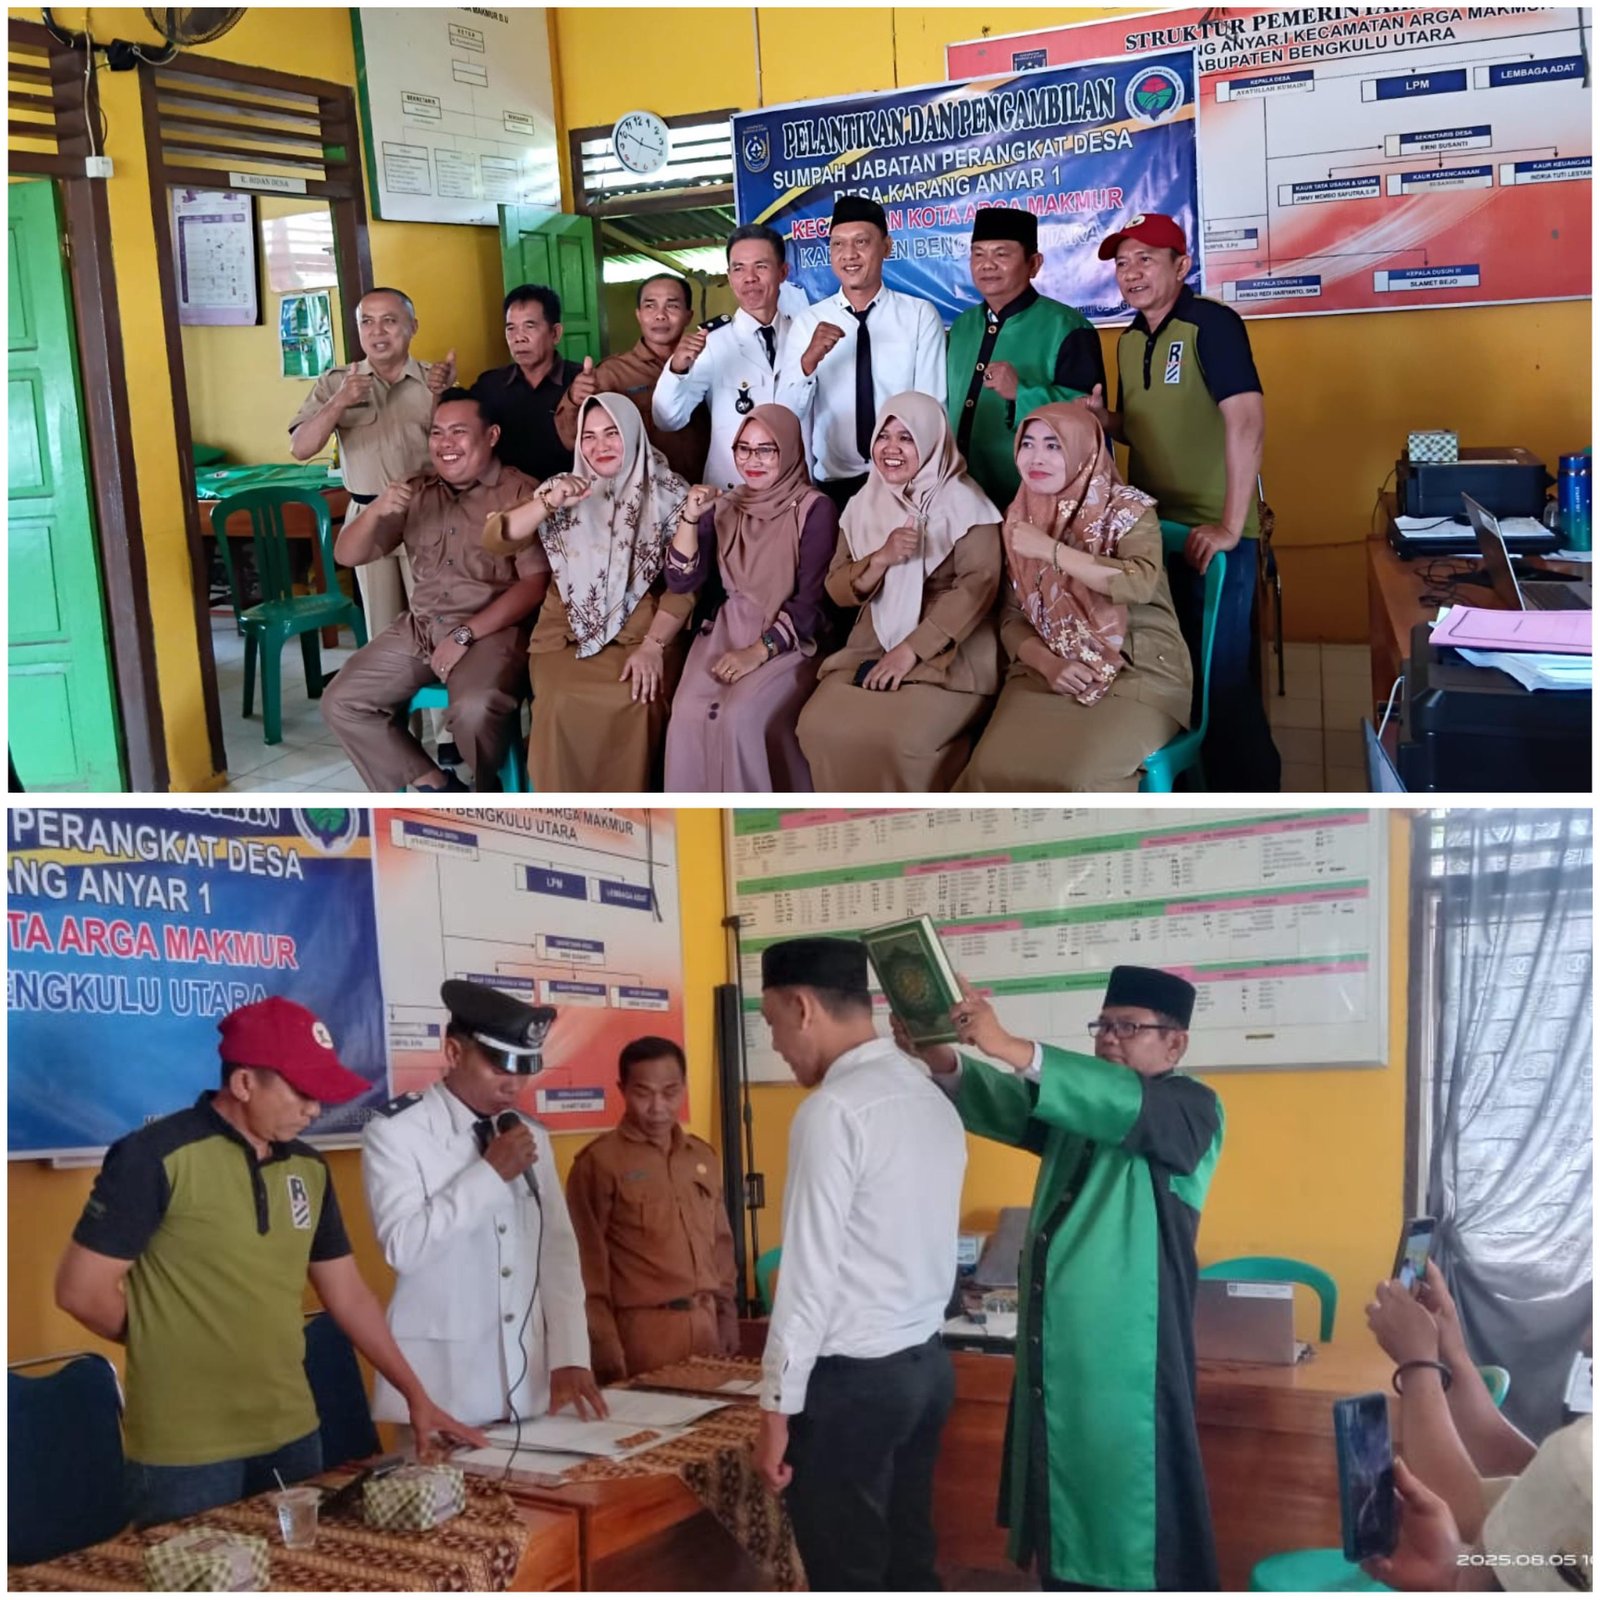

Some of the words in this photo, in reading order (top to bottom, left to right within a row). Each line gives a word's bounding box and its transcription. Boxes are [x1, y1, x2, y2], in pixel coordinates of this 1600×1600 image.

[1126, 18, 1245, 50] STRUKTUR
[1294, 15, 1404, 42] KECAMATAN
[1409, 9, 1463, 28] ARGA
[1289, 34, 1388, 61] BENGKULU
[1394, 27, 1456, 47] UTARA
[1250, 77, 1274, 85] KEPALA
[1405, 80, 1430, 91] LPM
[1501, 66, 1549, 79] LEMBAGA
[1550, 62, 1576, 73] ADAT
[783, 106, 907, 160] PELANTIKAN
[908, 98, 958, 144] DAN
[957, 77, 1116, 138] PENGAMBILAN
[1415, 131, 1454, 140] SEKRETARIS
[1455, 129, 1473, 137] DESA
[773, 163, 847, 190] SUMPAH
[851, 152, 936, 181] JABATAN
[942, 136, 1069, 170] PERANGKAT
[1073, 128, 1133, 155] DESA
[1553, 158, 1591, 167] KEUANGAN
[888, 178, 971, 203] KARANG
[975, 167, 1045, 194] ANYAR
[1051, 165, 1061, 186] 1
[907, 204, 962, 230] KOTA
[1026, 186, 1124, 218] MAKMUR
[1169, 343, 1181, 362] R
[536, 820, 578, 841] UTARA
[583, 811, 634, 835] MAKMUR
[12, 808, 219, 869] PERANGKAT
[228, 838, 304, 880] DESA
[78, 867, 190, 913] ANYAR
[198, 882, 211, 914] 1
[58, 914, 161, 960] ARGA
[163, 924, 300, 970] MAKMUR
[290, 1178, 306, 1201] R
